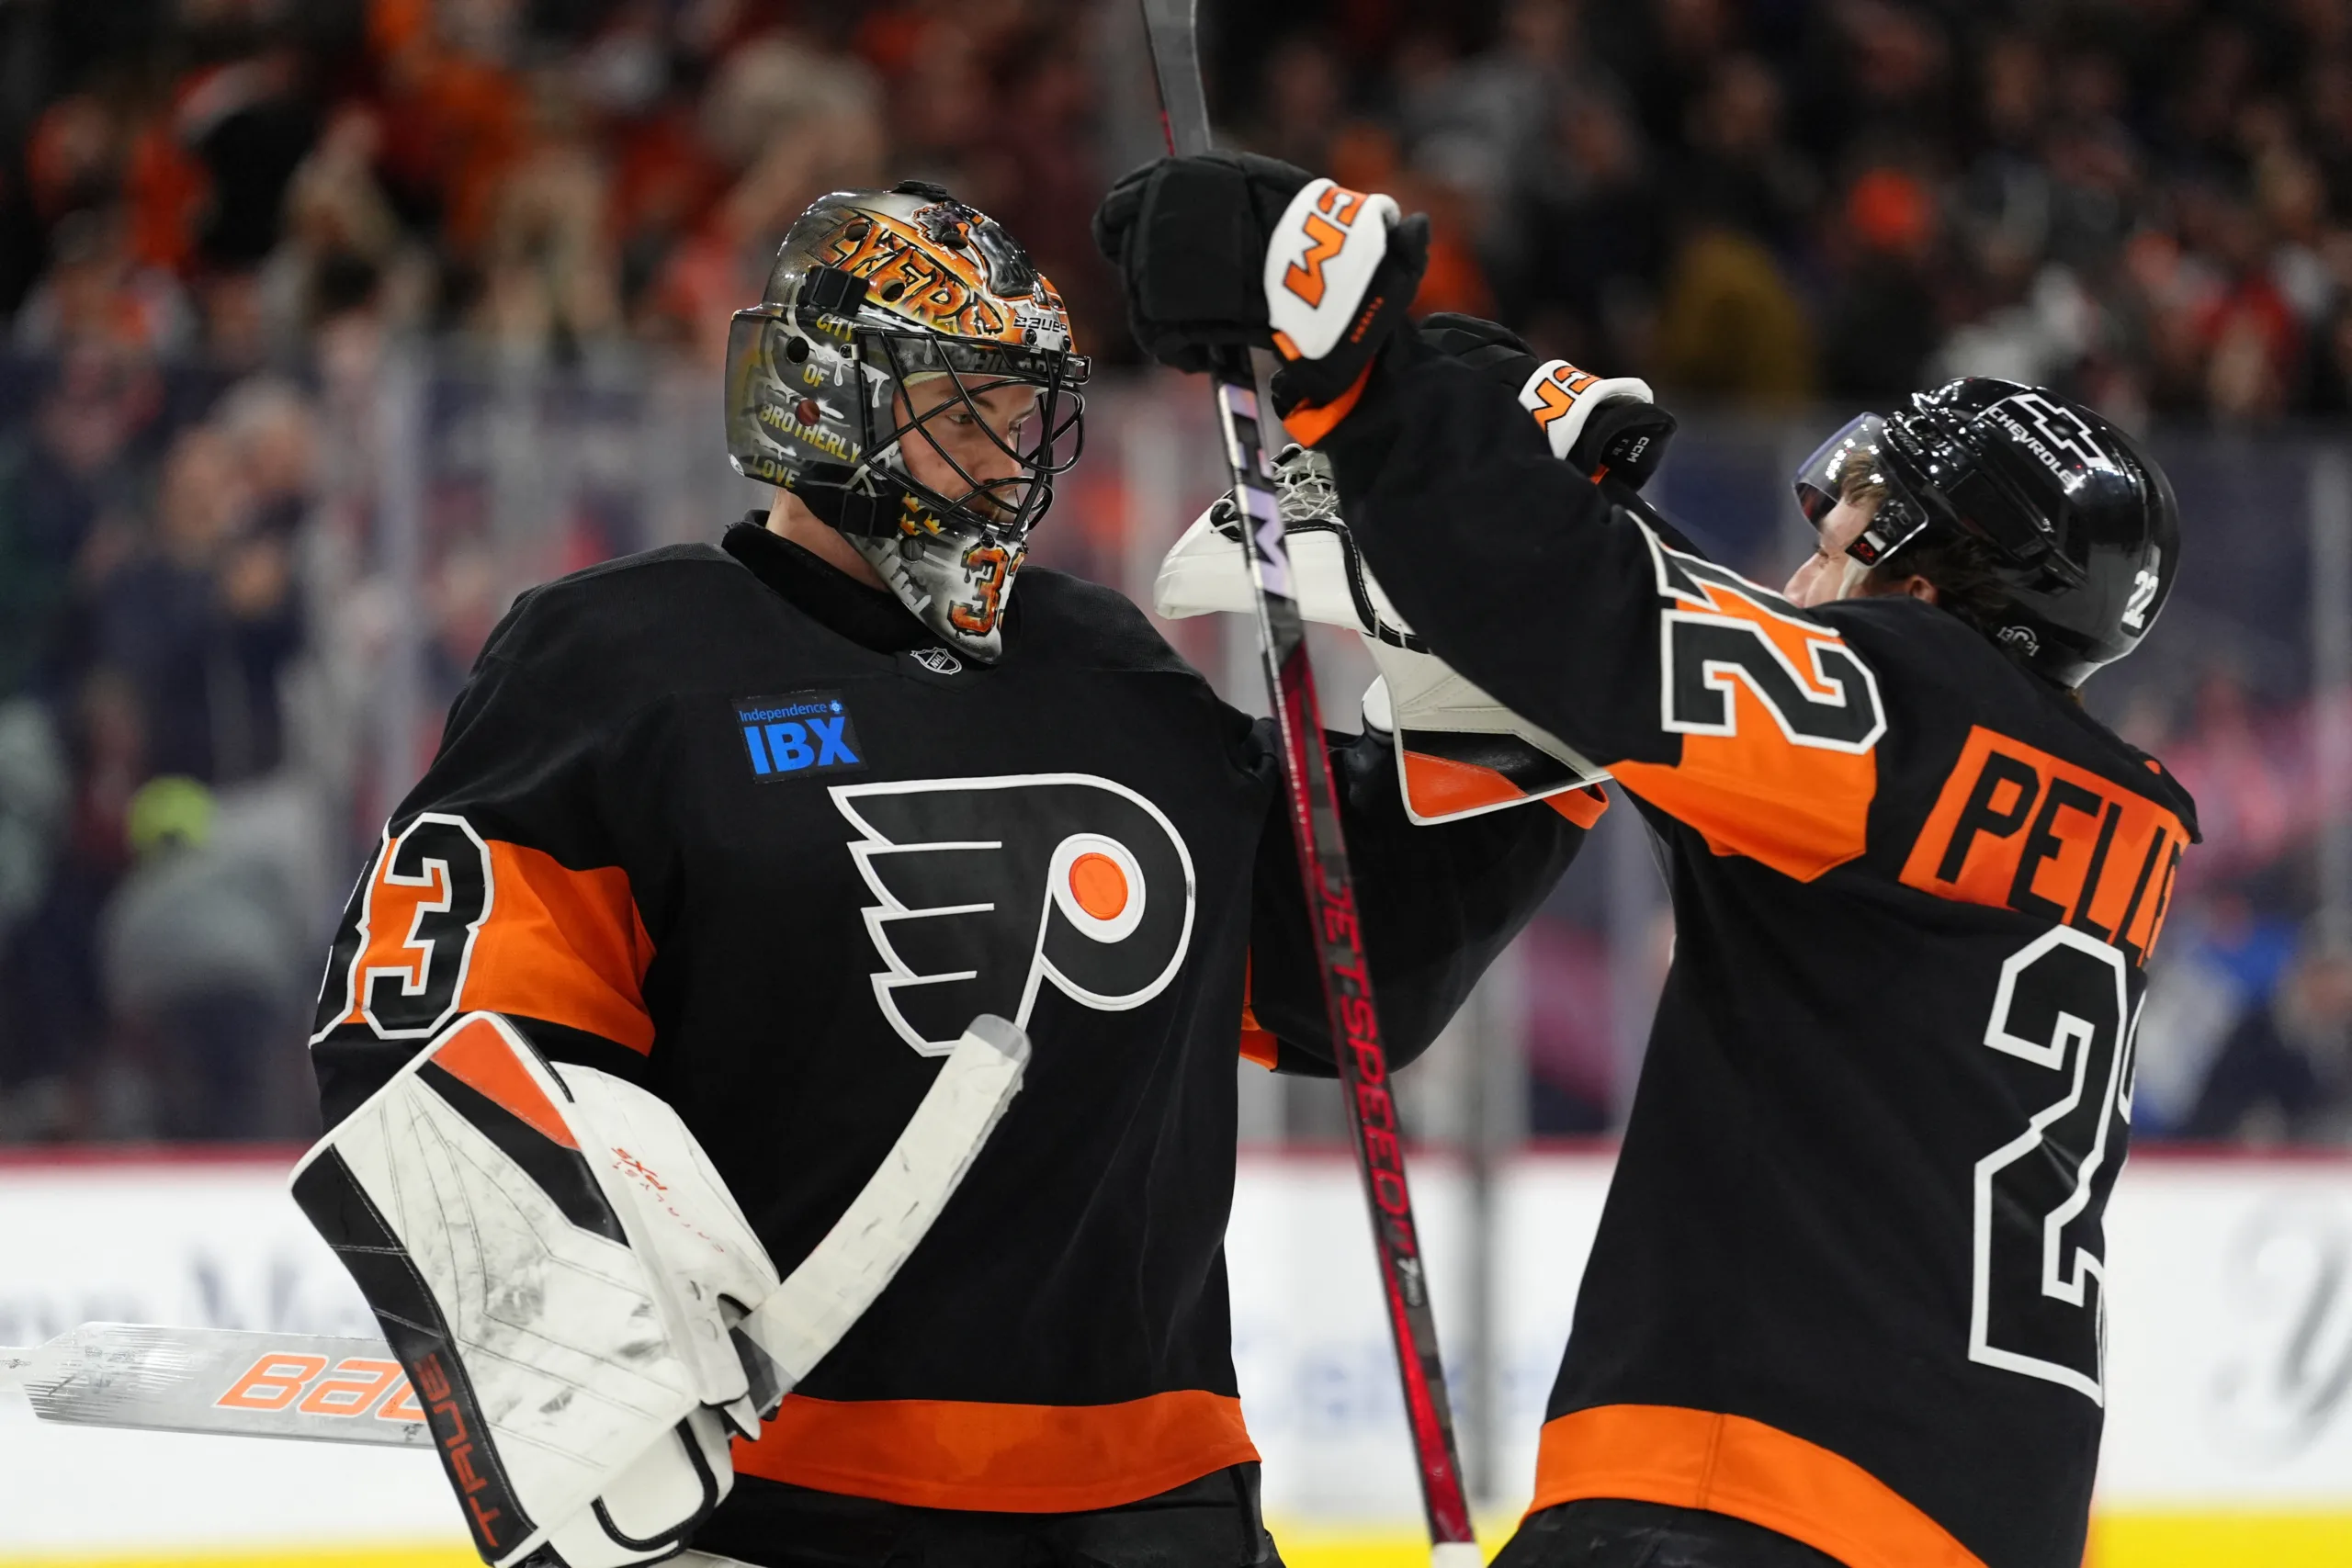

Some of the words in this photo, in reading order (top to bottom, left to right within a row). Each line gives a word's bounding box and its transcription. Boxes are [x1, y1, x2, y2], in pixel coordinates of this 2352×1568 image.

[816, 312, 854, 342] CITY
[803, 363, 831, 388] OF
[760, 402, 863, 464] BROTHERLY
[1626, 436, 1650, 463] CCM
[752, 453, 800, 489] LOVE
[946, 542, 1024, 637] 3
[2120, 570, 2159, 629] 22
[929, 653, 945, 669] NHL
[739, 694, 828, 722] Independence
[744, 716, 860, 775] IBX
[1314, 863, 1410, 1215] JETSPEED
[1968, 924, 2148, 1408] 2
[413, 1352, 501, 1548] TRUE
